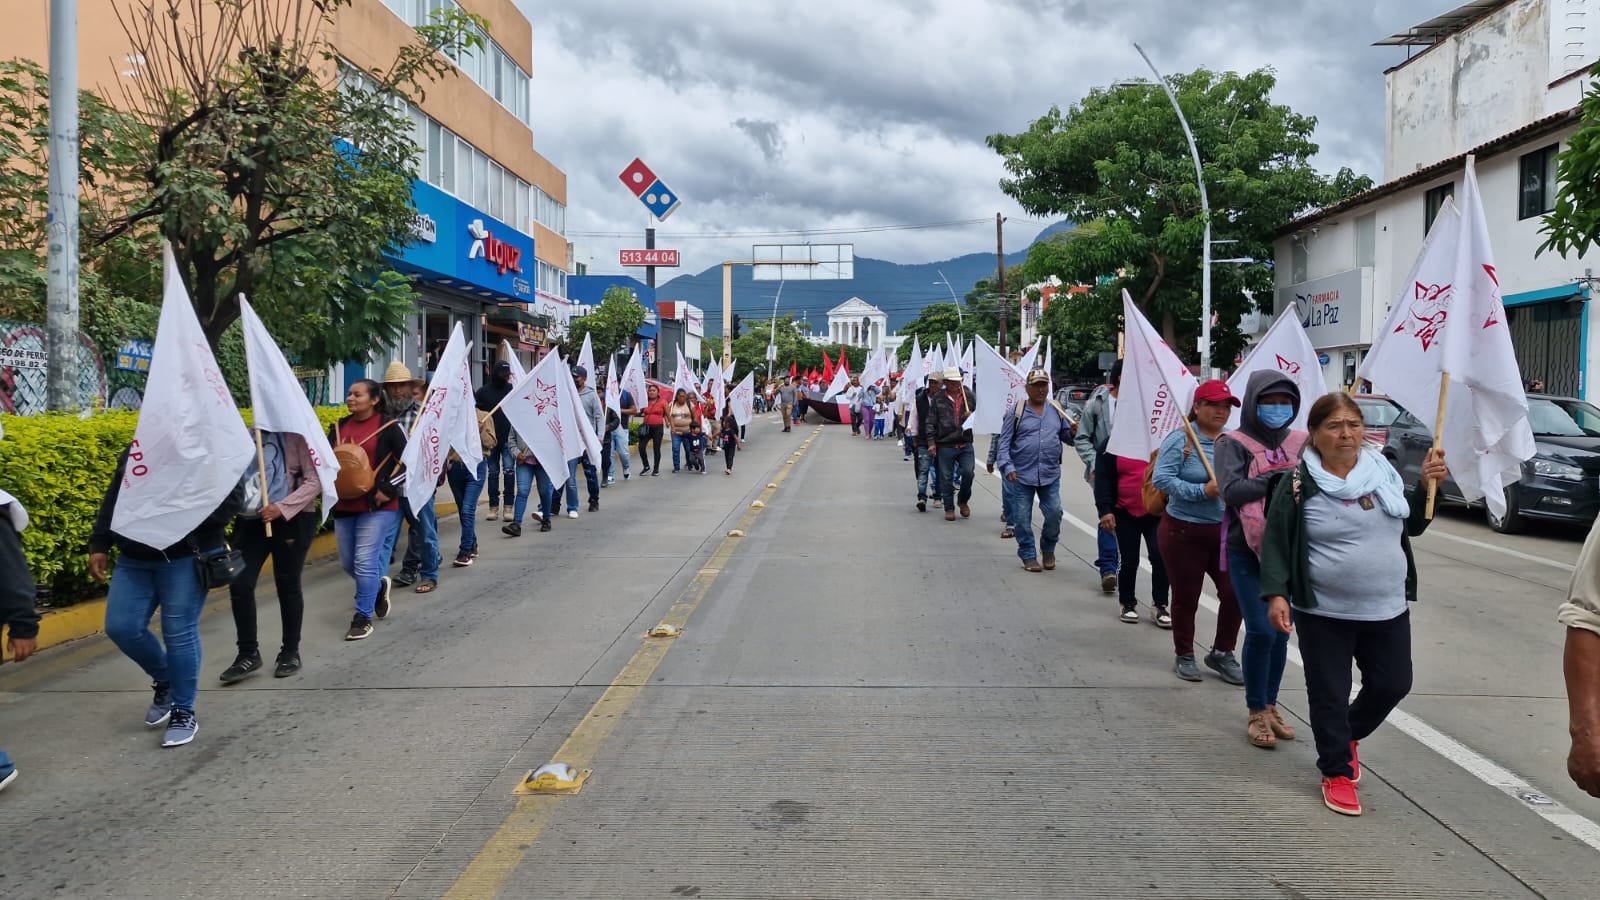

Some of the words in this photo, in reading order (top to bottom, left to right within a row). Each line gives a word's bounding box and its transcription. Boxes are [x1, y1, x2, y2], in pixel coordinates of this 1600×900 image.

[621, 252, 642, 263] 513
[645, 252, 658, 263] 44
[661, 252, 675, 263] 04
[1311, 291, 1339, 304] FARMACIA
[1311, 306, 1322, 327] La
[1323, 303, 1339, 325] Paz
[14, 350, 26, 359] DE
